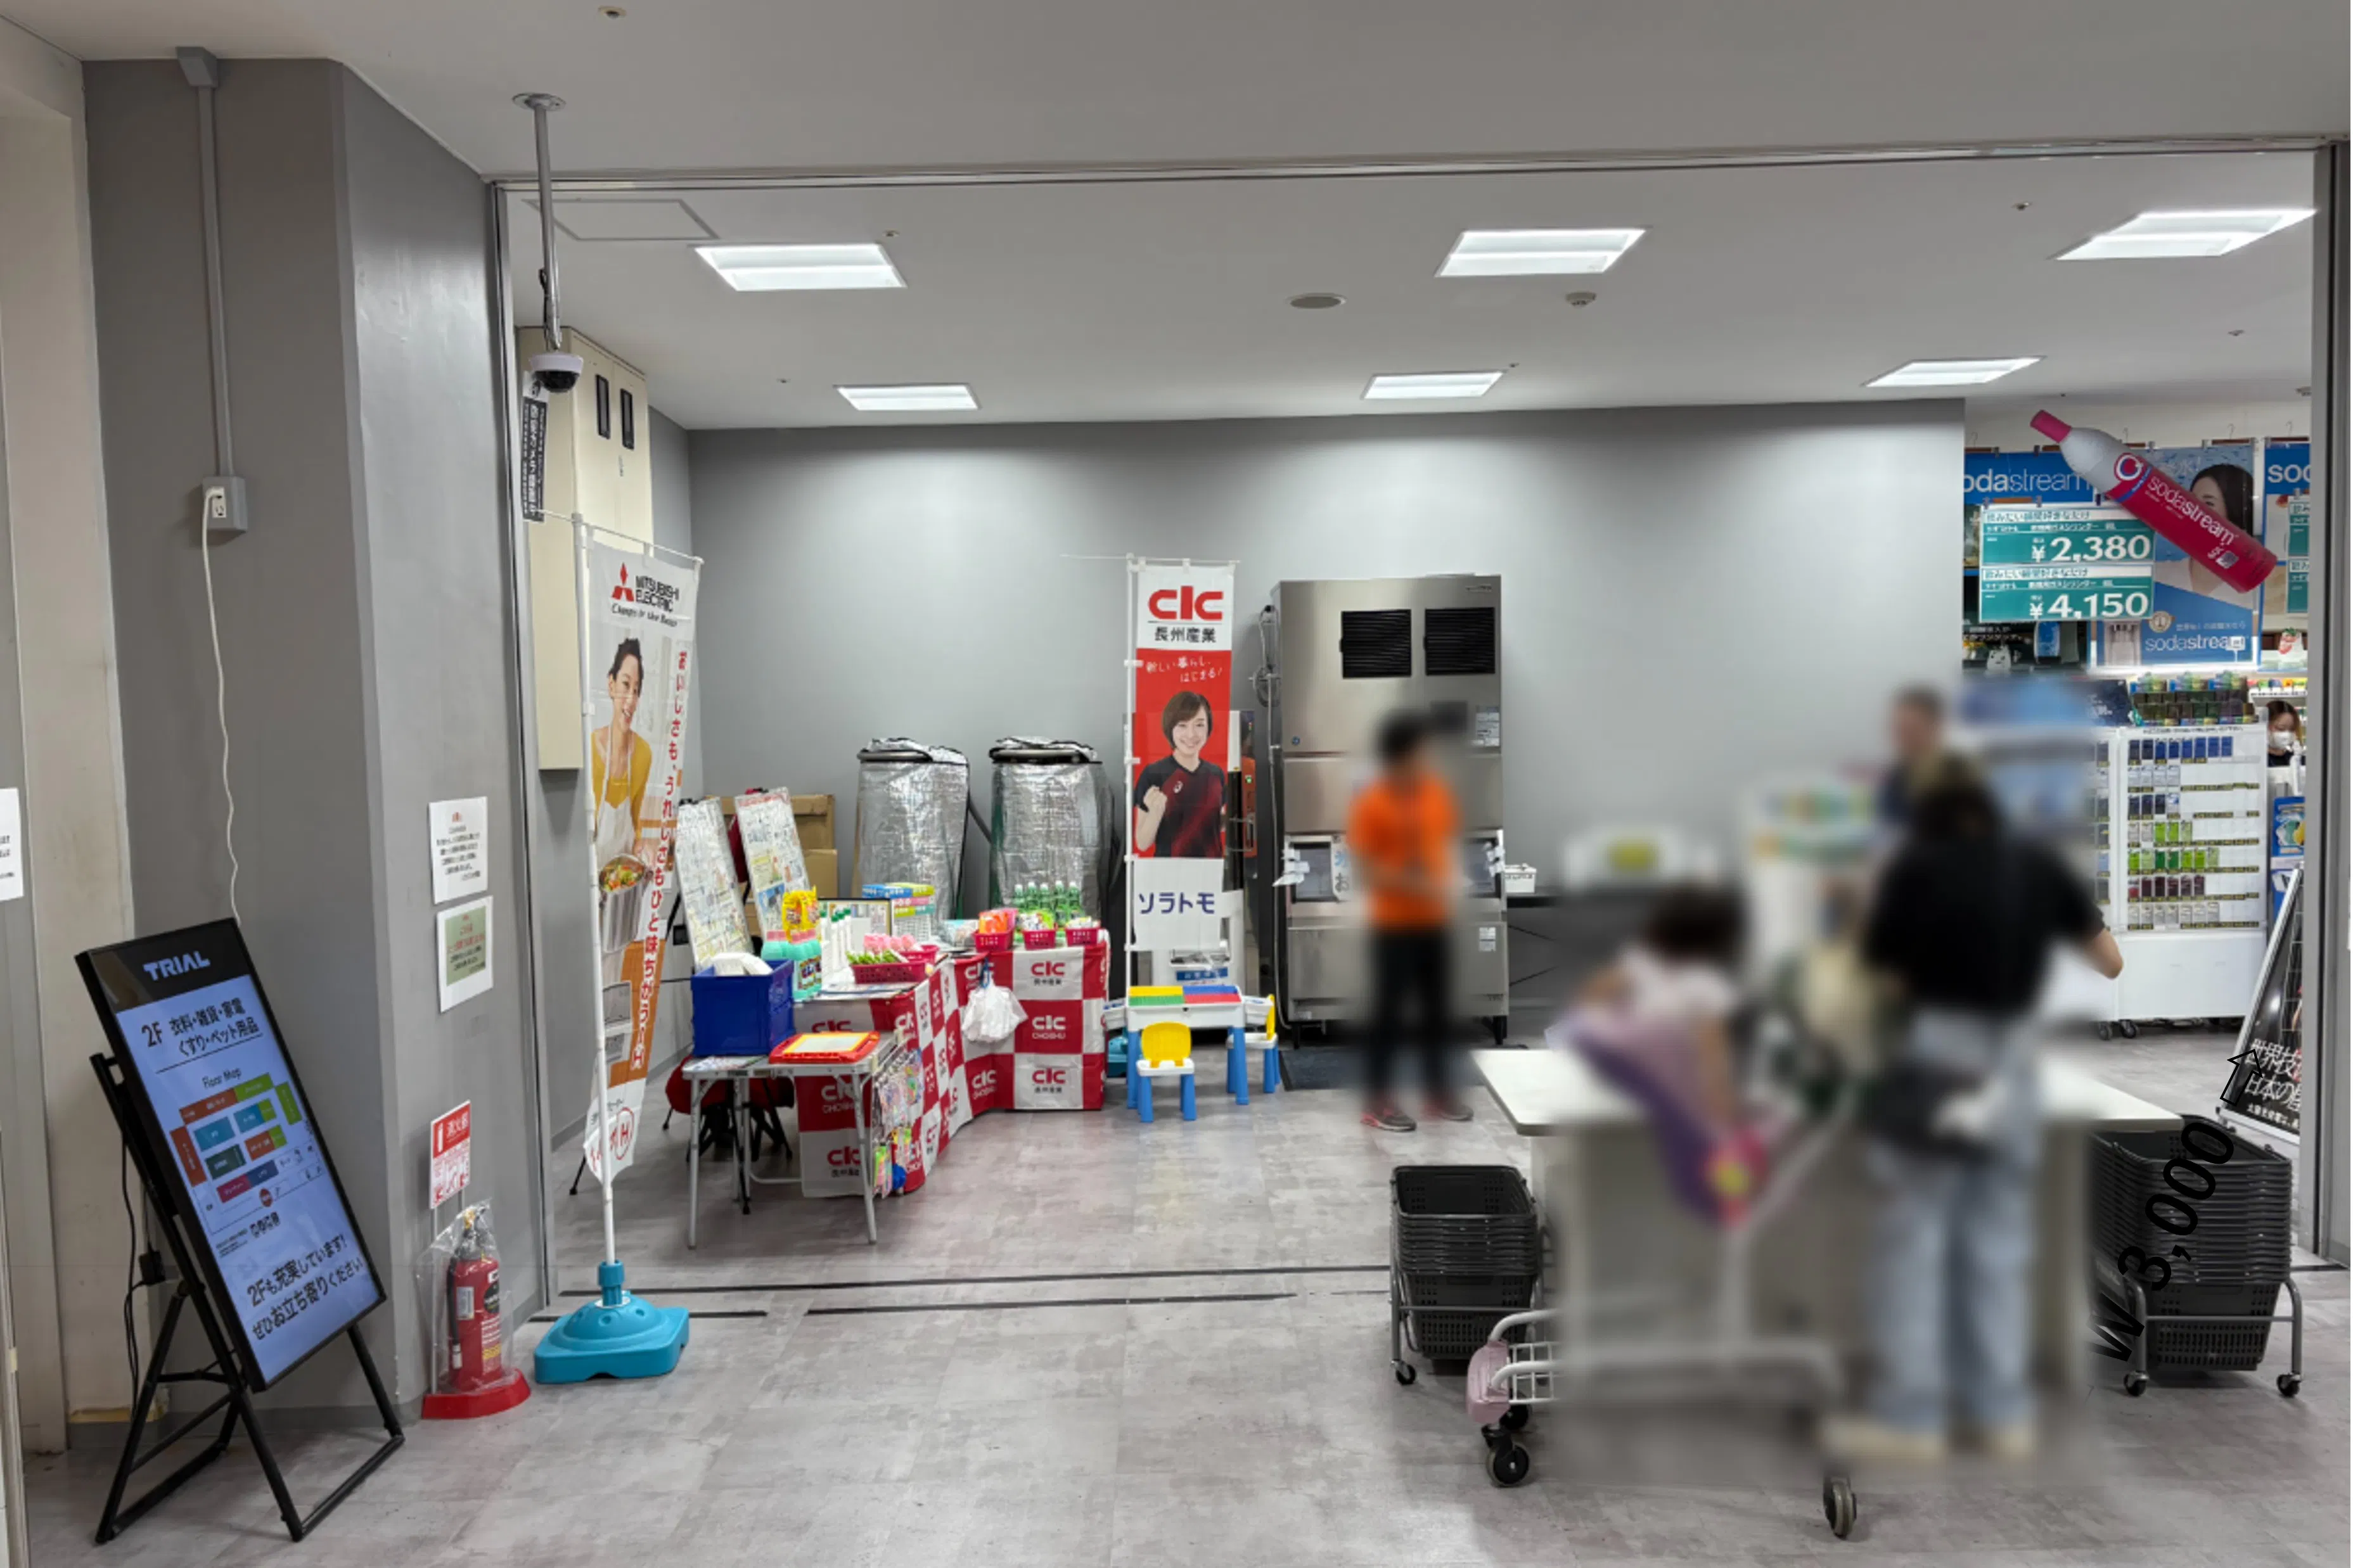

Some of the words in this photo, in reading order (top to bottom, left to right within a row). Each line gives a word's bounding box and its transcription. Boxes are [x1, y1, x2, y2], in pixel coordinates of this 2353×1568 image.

[2147, 476, 2235, 545] sodastream
[635, 575, 679, 601] MITSUBISHI
[635, 589, 674, 613] ELECTRIC
[1155, 627, 1216, 642] 長州産業
[2145, 634, 2232, 651] sodastrea
[1139, 892, 1215, 914] ソラトモ
[143, 950, 210, 982] TRIAL
[141, 1021, 162, 1047] 2F
[178, 1016, 260, 1057] くすり・ペット用品
[251, 1257, 364, 1340] ぜひお立ち寄りください
